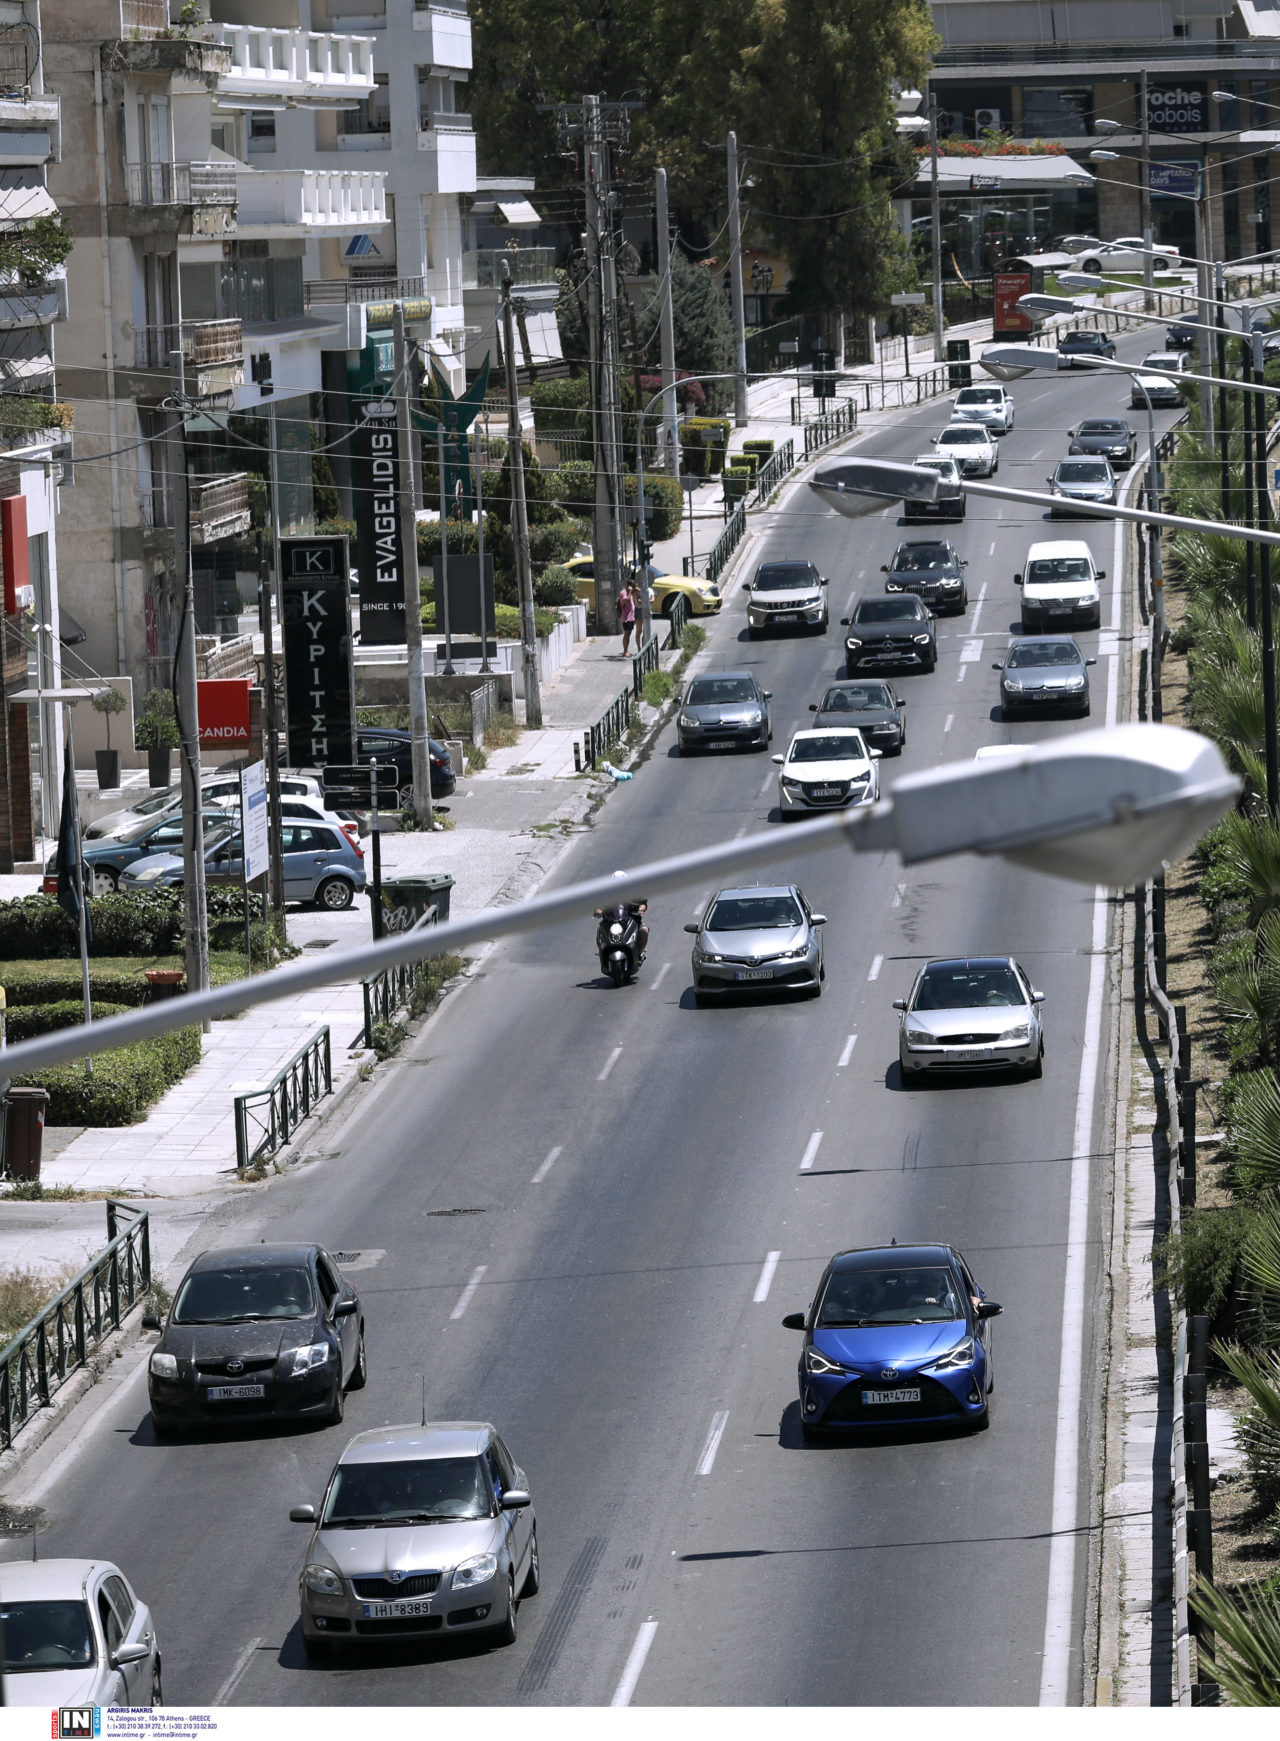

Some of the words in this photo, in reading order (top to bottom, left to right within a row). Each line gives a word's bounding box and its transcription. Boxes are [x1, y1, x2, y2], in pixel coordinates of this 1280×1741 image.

[371, 433, 397, 583] EVAGELIDIS
[362, 603, 389, 611] SINCE
[301, 589, 328, 769] ΚΥΡΙΤΣΗ
[219, 1387, 262, 1399] IMK-6098
